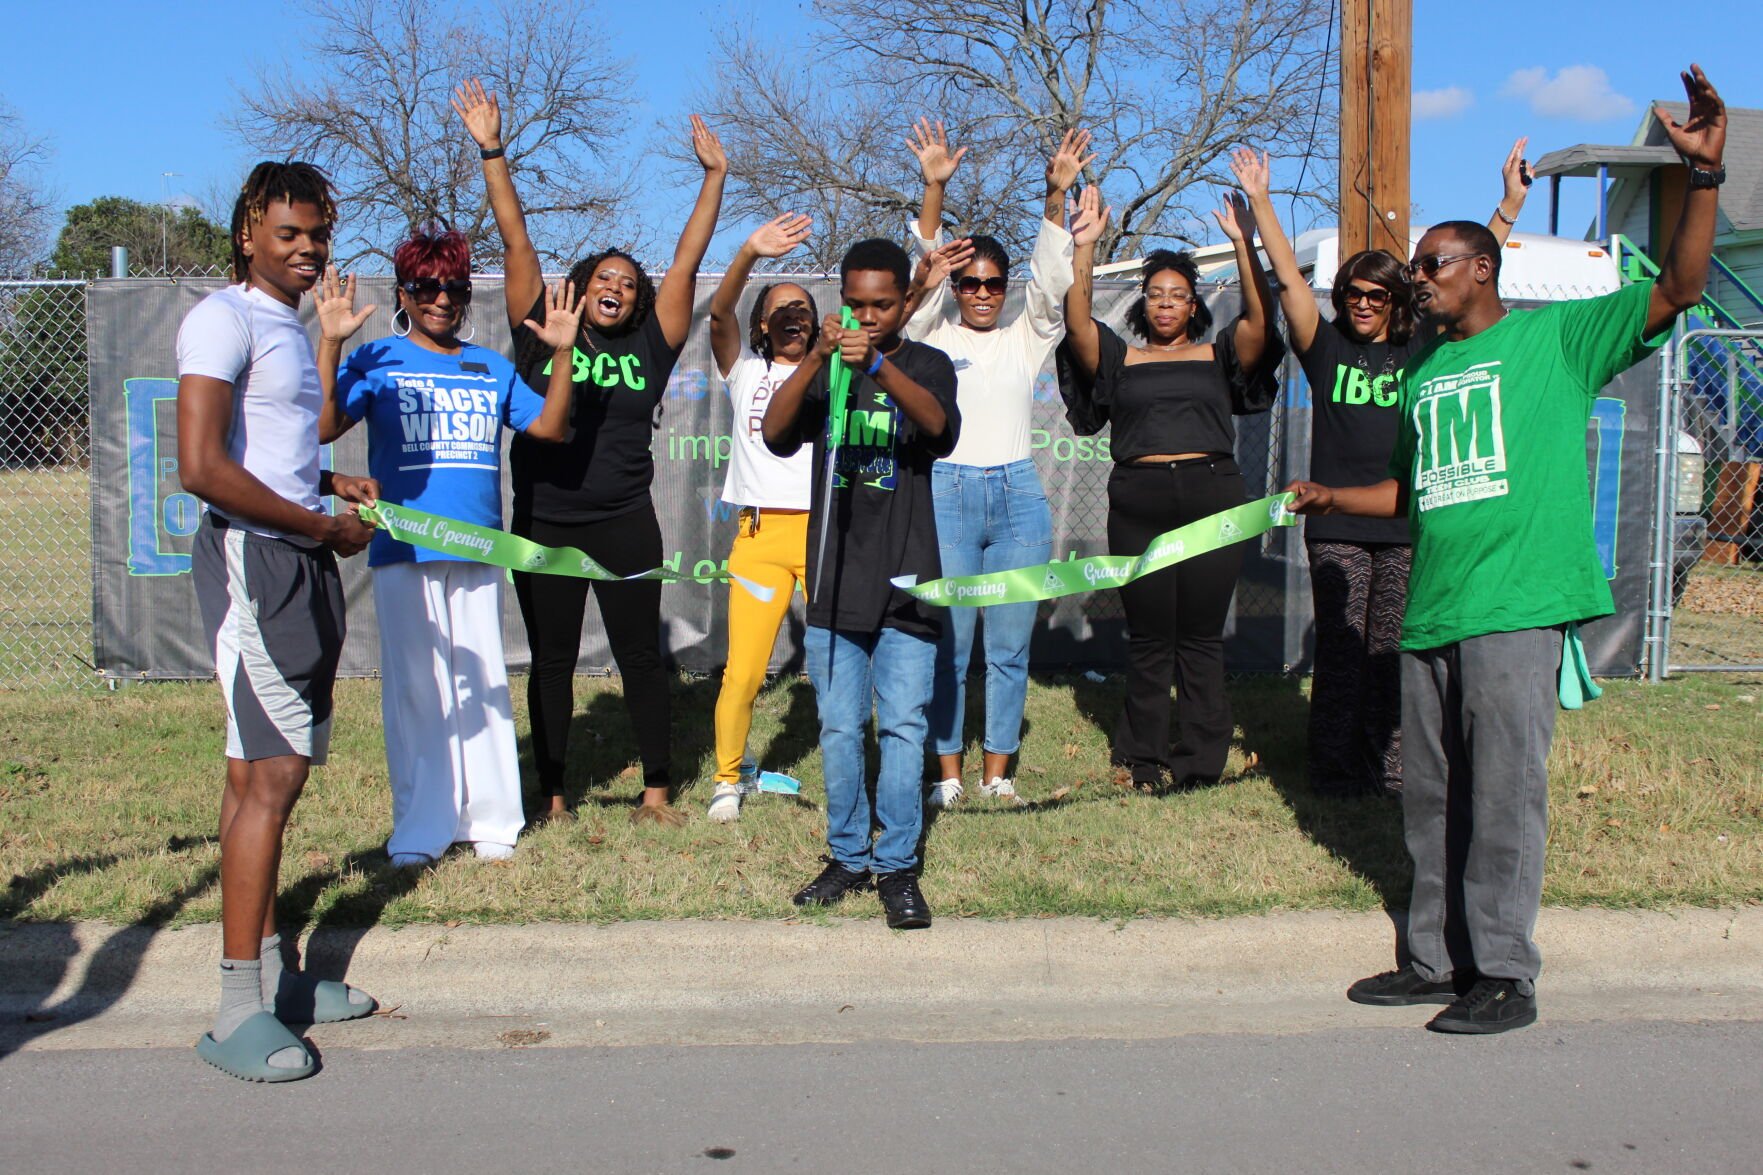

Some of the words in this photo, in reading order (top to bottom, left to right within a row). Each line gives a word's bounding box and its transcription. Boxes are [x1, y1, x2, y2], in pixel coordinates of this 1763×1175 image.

[396, 378, 424, 388] Vote
[426, 379, 435, 388] 4
[1333, 364, 1404, 407] IBC
[398, 387, 498, 415] STACEY
[400, 412, 499, 443] WILSON
[402, 442, 419, 452] BELL
[420, 441, 450, 451] COUNTY
[435, 450, 472, 460] PRECINCT
[473, 451, 479, 460] 2
[1421, 459, 1496, 483] POSSIBLE
[1454, 475, 1490, 487] CLUB
[381, 507, 429, 536] Grand
[431, 519, 494, 556] Opening
[944, 579, 1008, 600] Opening
[1084, 562, 1130, 585] Grand
